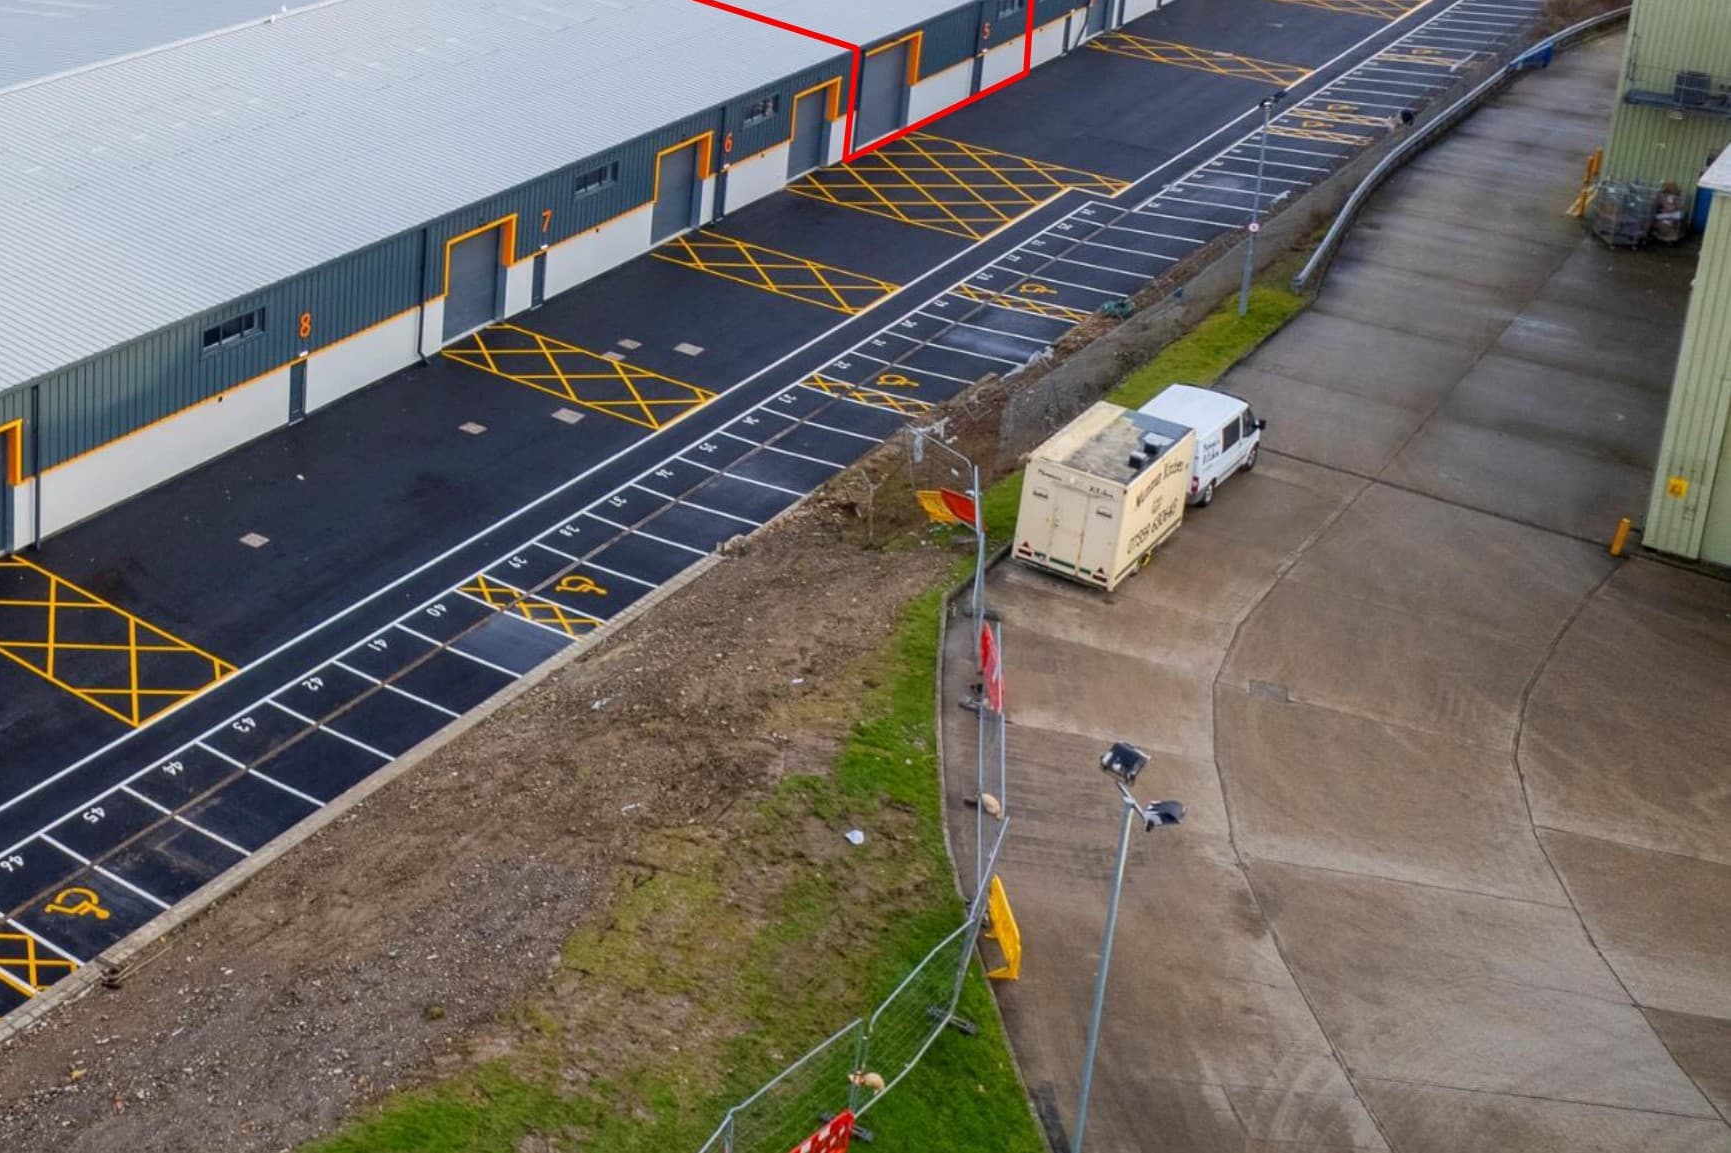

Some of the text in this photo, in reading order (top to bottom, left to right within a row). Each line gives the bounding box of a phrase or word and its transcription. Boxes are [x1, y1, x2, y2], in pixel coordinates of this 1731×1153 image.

[982, 21, 991, 39] 5
[723, 132, 733, 153] 6
[541, 208, 552, 233] 7
[299, 312, 311, 338] 8
[655, 468, 674, 479] 36
[607, 495, 628, 508] 37
[558, 524, 581, 537] 38
[507, 555, 529, 569] 39
[425, 603, 448, 618] 40
[367, 638, 389, 652] 41
[301, 676, 324, 691] 42
[232, 716, 257, 734] 43
[161, 760, 185, 776] 44
[82, 806, 106, 824] 45
